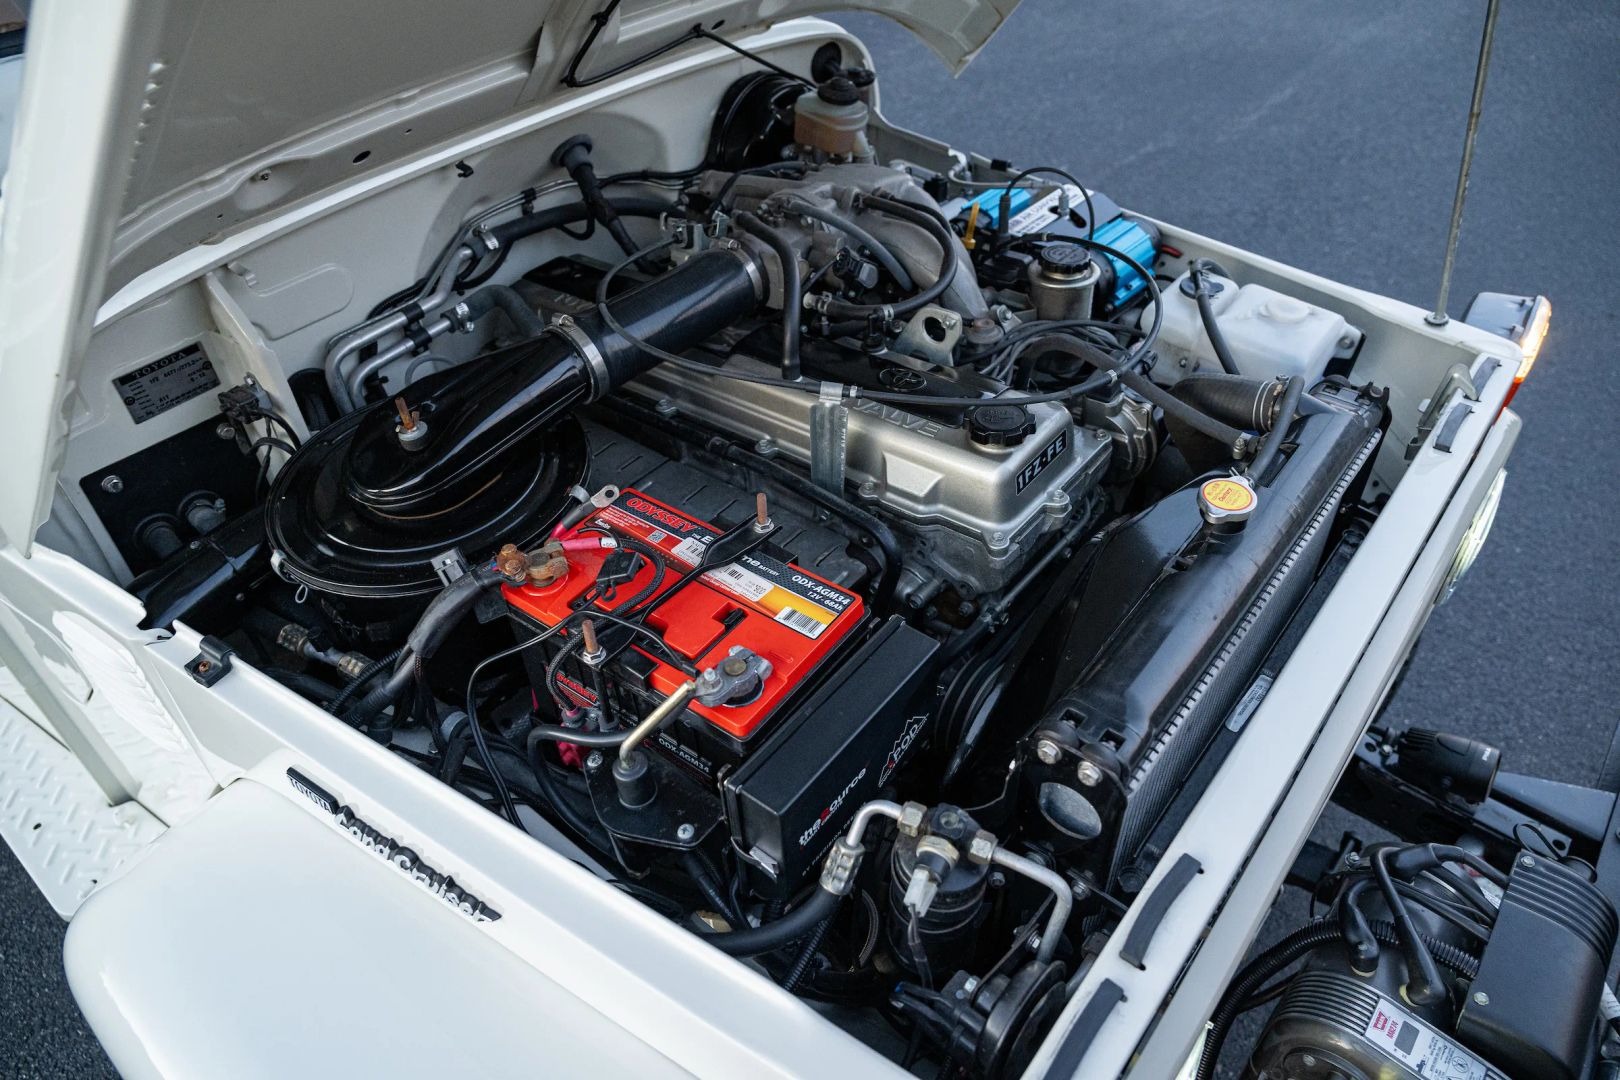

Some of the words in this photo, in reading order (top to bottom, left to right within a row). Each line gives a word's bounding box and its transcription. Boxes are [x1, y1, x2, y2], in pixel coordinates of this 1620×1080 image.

[132, 352, 187, 379] TOYOTA
[1017, 436, 1065, 492] 1FZ-FE
[626, 497, 698, 533] ODYSSEY
[791, 574, 852, 606] ODX-AGM34
[807, 591, 820, 602] 12V
[823, 598, 844, 611] 68Ah
[658, 737, 710, 774] ODX-AGM34
[287, 772, 337, 814] TOYOTA
[335, 808, 395, 862] Land
[393, 848, 501, 923] Cruiser
